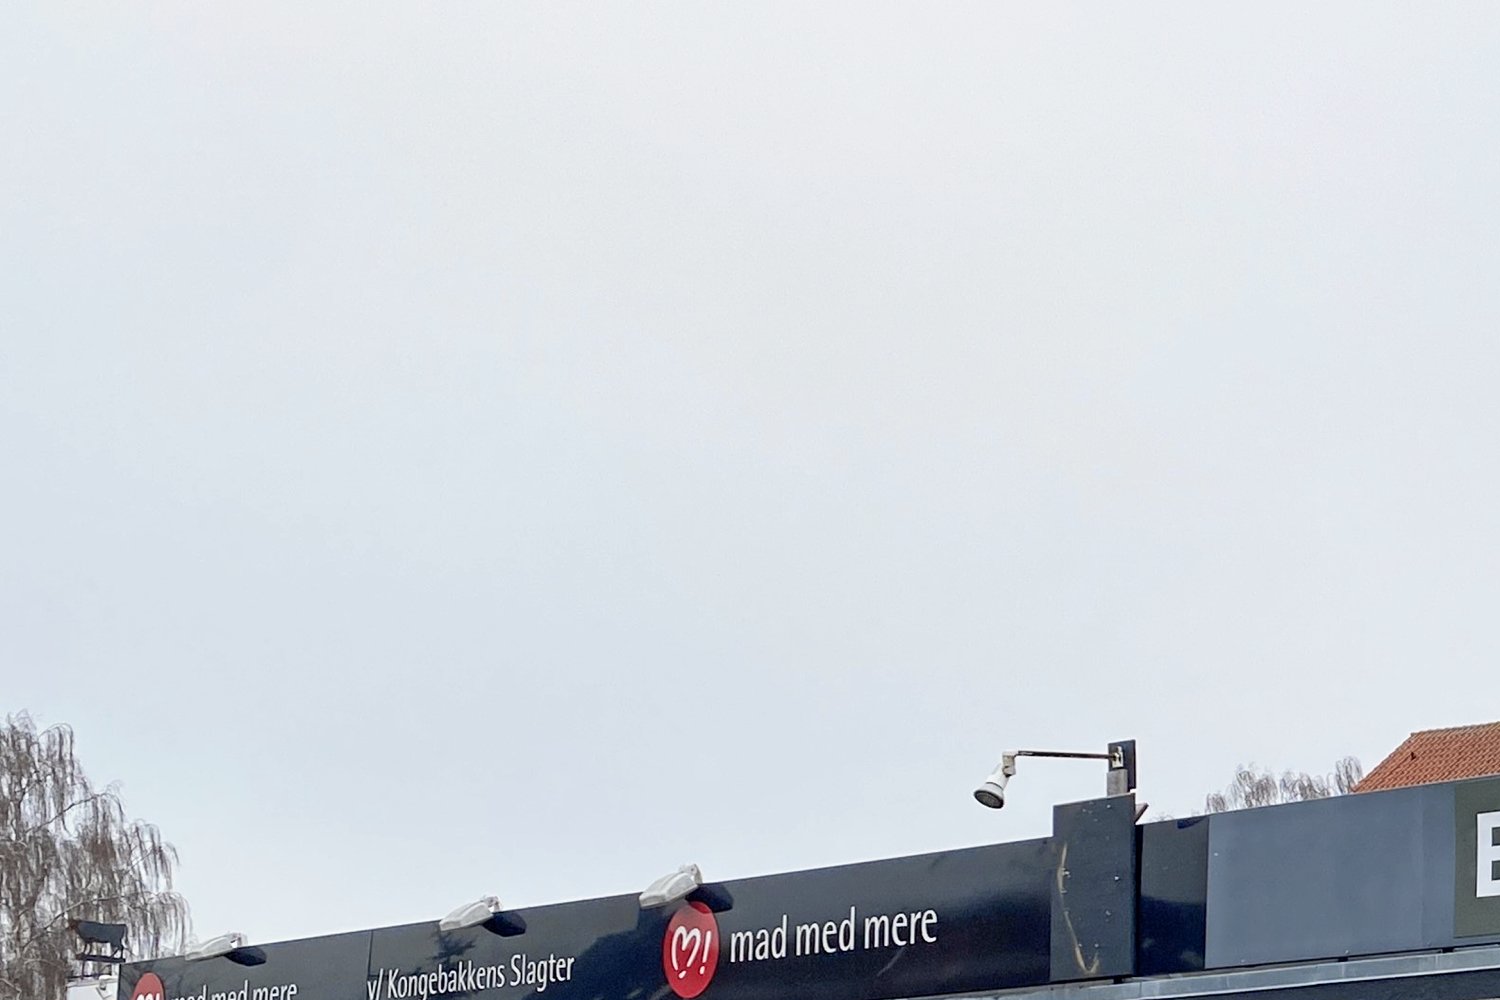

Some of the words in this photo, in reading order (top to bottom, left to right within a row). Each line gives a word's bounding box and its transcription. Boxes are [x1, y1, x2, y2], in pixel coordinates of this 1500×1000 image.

[729, 913, 788, 963] mad
[795, 905, 856, 957] med
[863, 908, 938, 950] mere
[510, 953, 575, 992] Slagter
